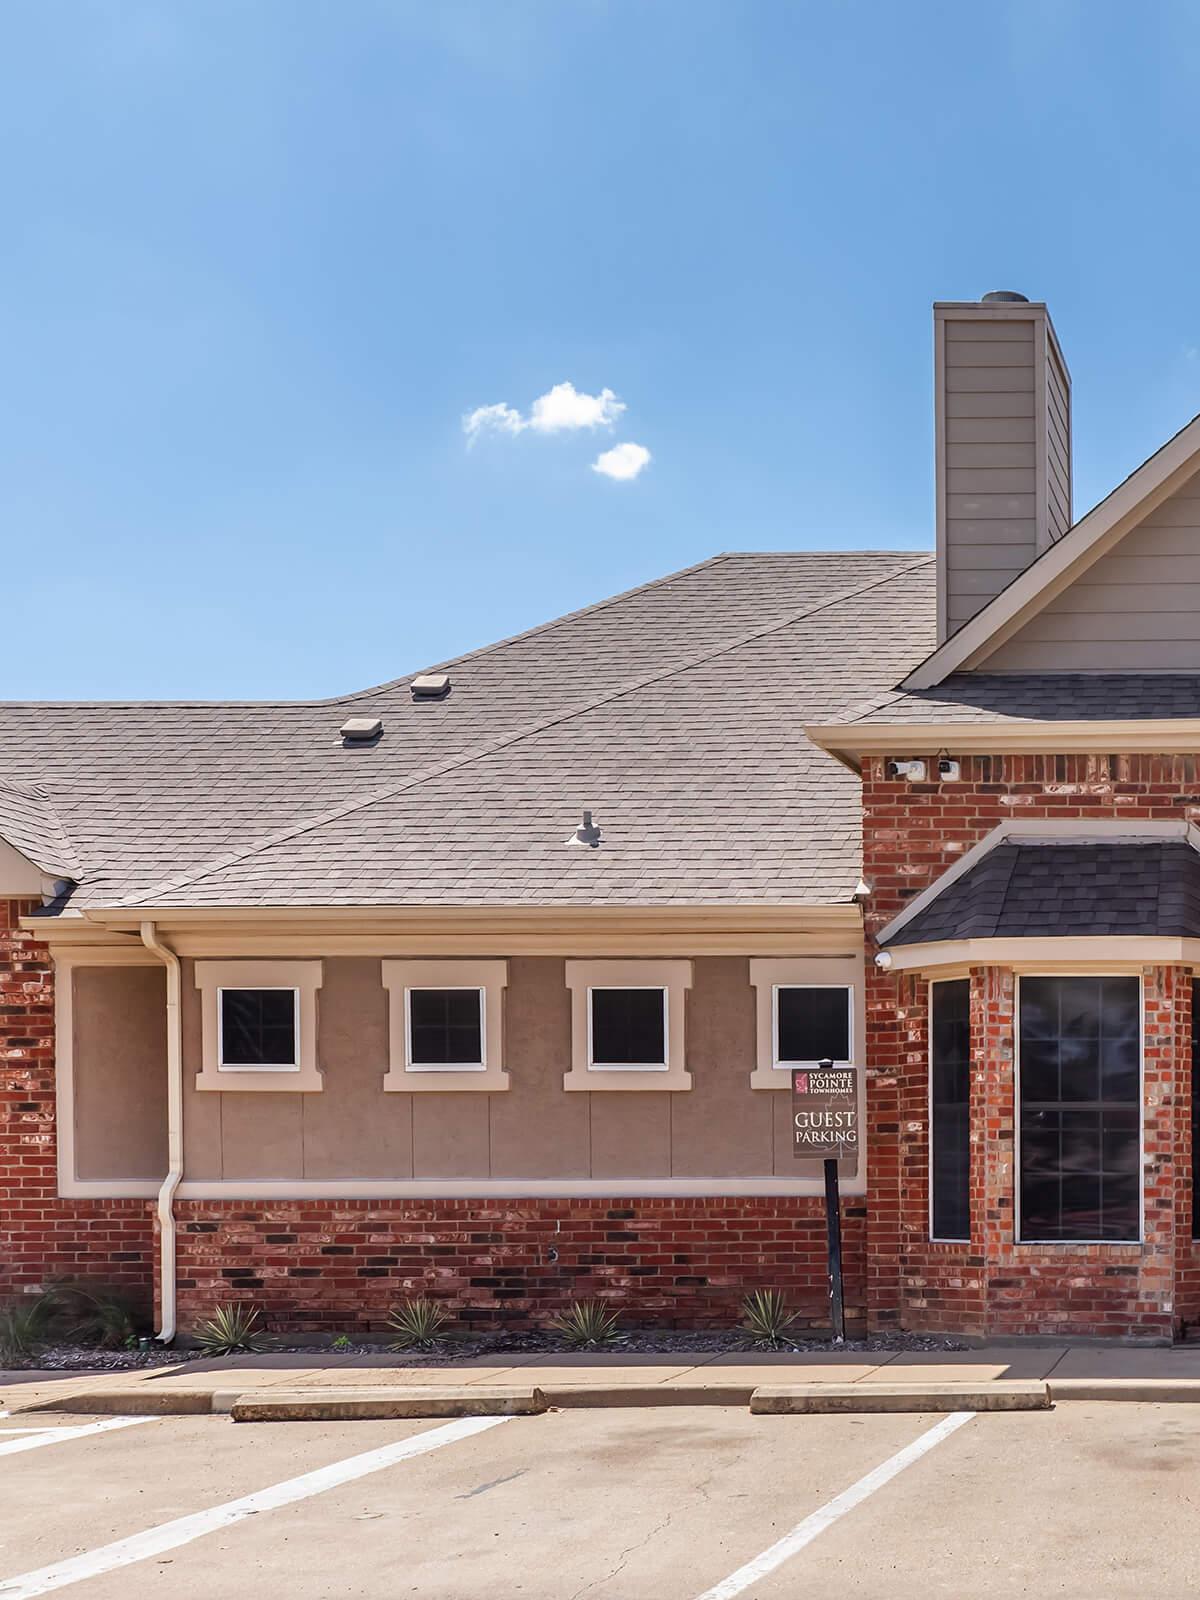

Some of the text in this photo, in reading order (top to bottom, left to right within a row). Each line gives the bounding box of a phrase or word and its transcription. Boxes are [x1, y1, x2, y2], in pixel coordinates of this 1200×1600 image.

[810, 1079, 852, 1088] POINTE
[795, 1112, 855, 1127] GUEST
[796, 1131, 856, 1143] PARKING
